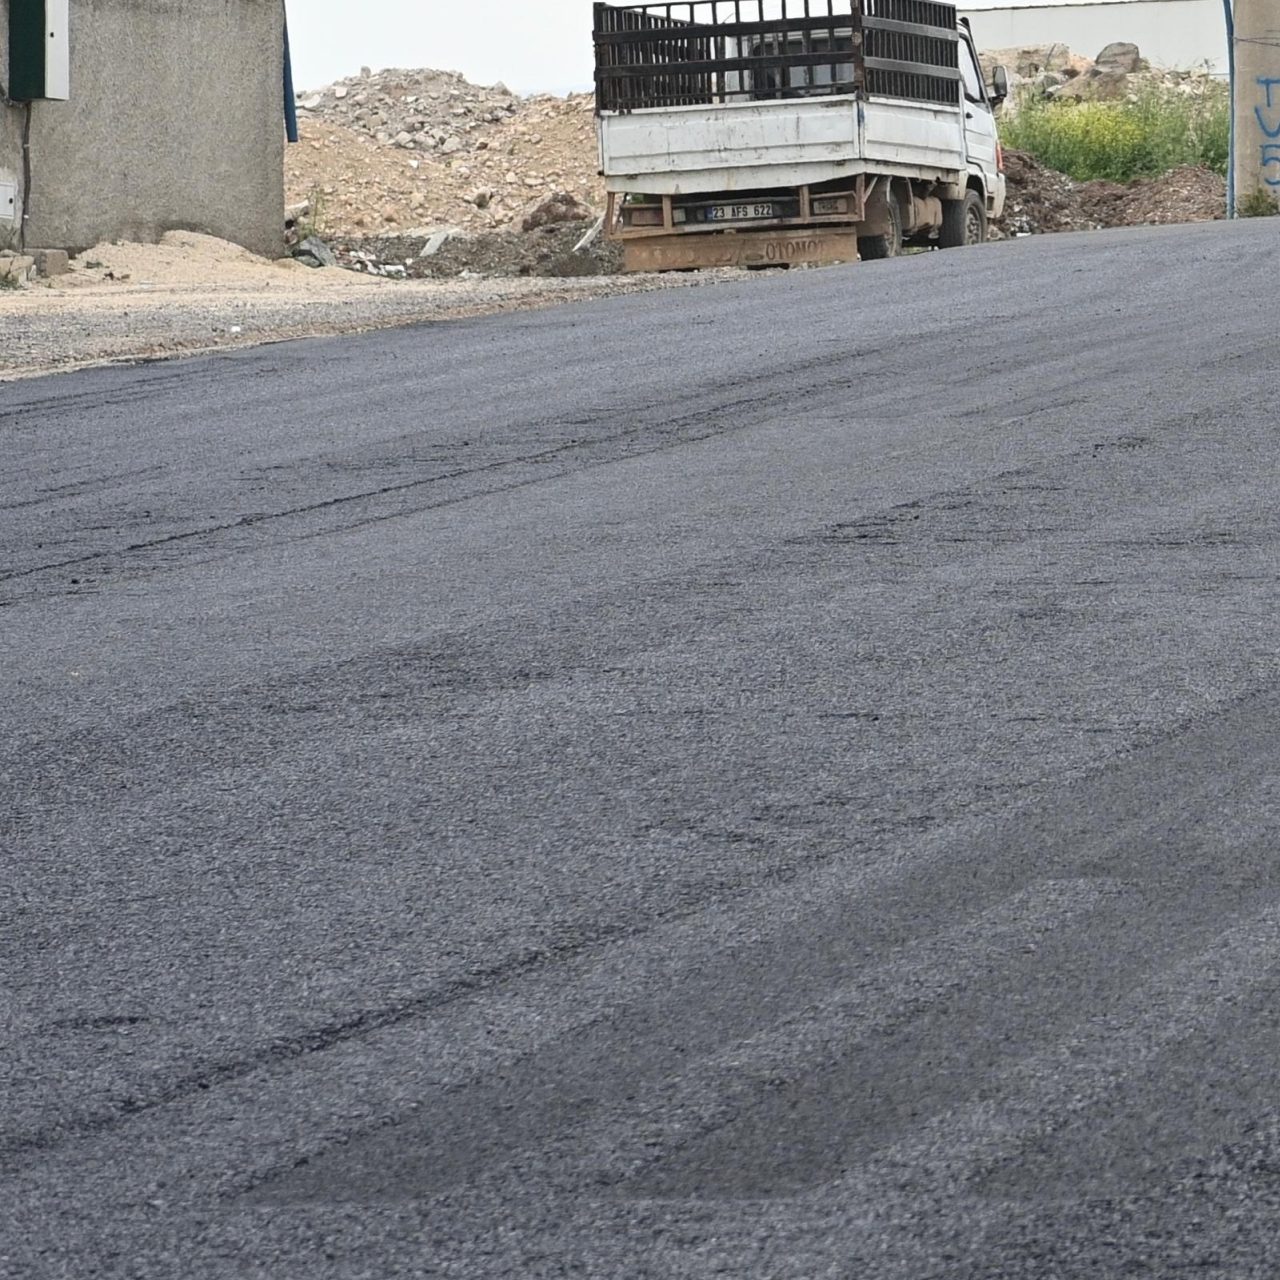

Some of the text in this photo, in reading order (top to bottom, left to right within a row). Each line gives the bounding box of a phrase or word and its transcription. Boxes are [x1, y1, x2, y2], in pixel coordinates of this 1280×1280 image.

[713, 204, 773, 219] 23 AFS 622
